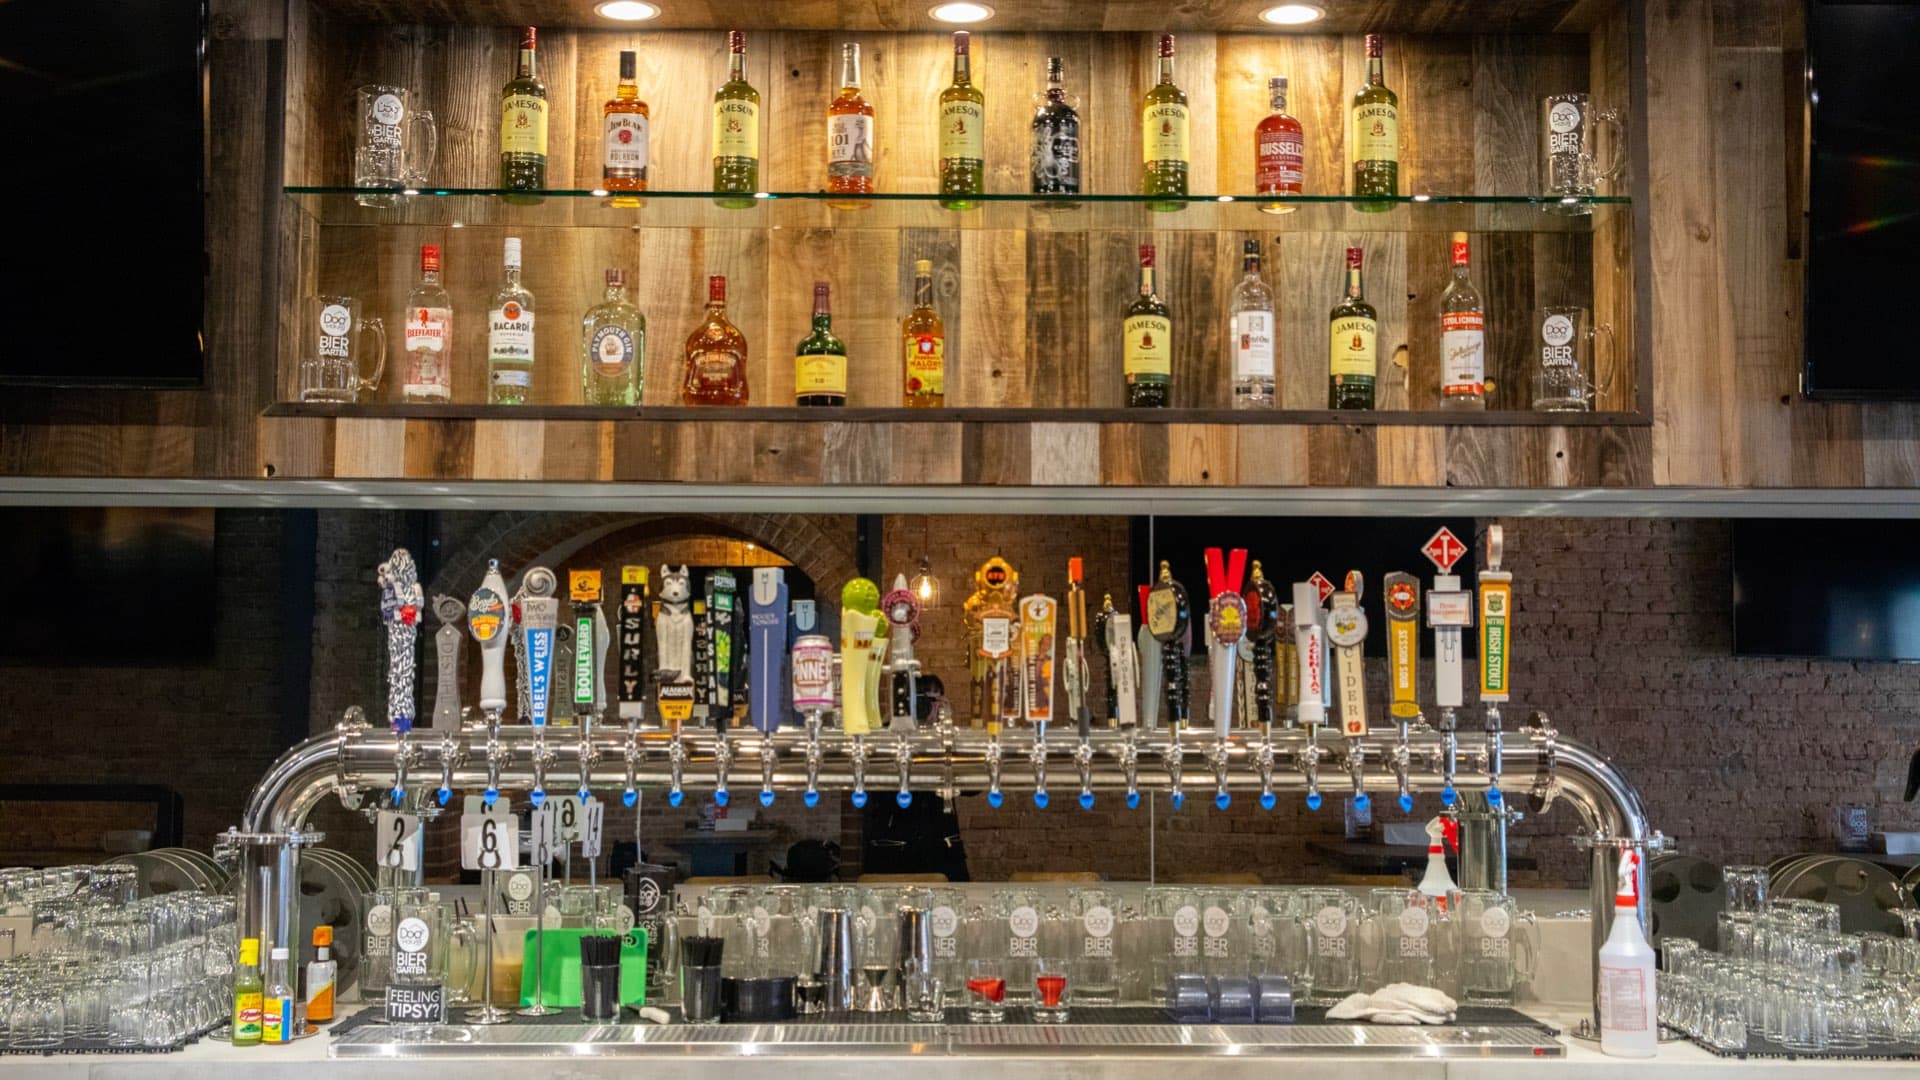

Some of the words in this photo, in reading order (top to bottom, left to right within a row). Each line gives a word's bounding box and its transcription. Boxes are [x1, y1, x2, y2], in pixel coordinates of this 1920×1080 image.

[504, 100, 543, 112] JAMESON
[1358, 108, 1396, 121] JAMESON
[373, 124, 402, 138] BIER
[832, 134, 848, 147] 101
[1550, 132, 1579, 146] BIER
[407, 329, 441, 337] BEEFEATER
[1128, 321, 1167, 333] JAMESON
[1336, 322, 1375, 334] JAMESON
[320, 335, 349, 349] BIER
[592, 326, 626, 353] PLYMOUTH
[623, 337, 633, 353] GIN
[319, 348, 349, 357] GARTEN
[1543, 346, 1572, 359] BIER
[1488, 627, 1501, 655] IRISH
[534, 632, 546, 672] WEISS
[624, 617, 640, 694] SURLY
[707, 595, 716, 704] ELYSIAN
[577, 623, 591, 698] BOULEVARD
[1488, 655, 1502, 689] STOUT
[1343, 647, 1359, 716] CIDER
[534, 677, 545, 718] EBEL'S
[393, 817, 405, 849] 2
[482, 819, 497, 852] 6
[508, 901, 530, 913] BIER
[400, 927, 423, 939] Dog
[1009, 937, 1037, 950] BIER
[1085, 937, 1112, 950] BIER
[1318, 937, 1346, 951] BIER
[1400, 937, 1429, 950] BIER
[1482, 938, 1510, 951] BIER
[397, 952, 427, 966] BIER
[396, 966, 427, 974] GARTEN
[391, 989, 440, 1003] FEELING
[390, 1002, 440, 1019] TIPSY?
